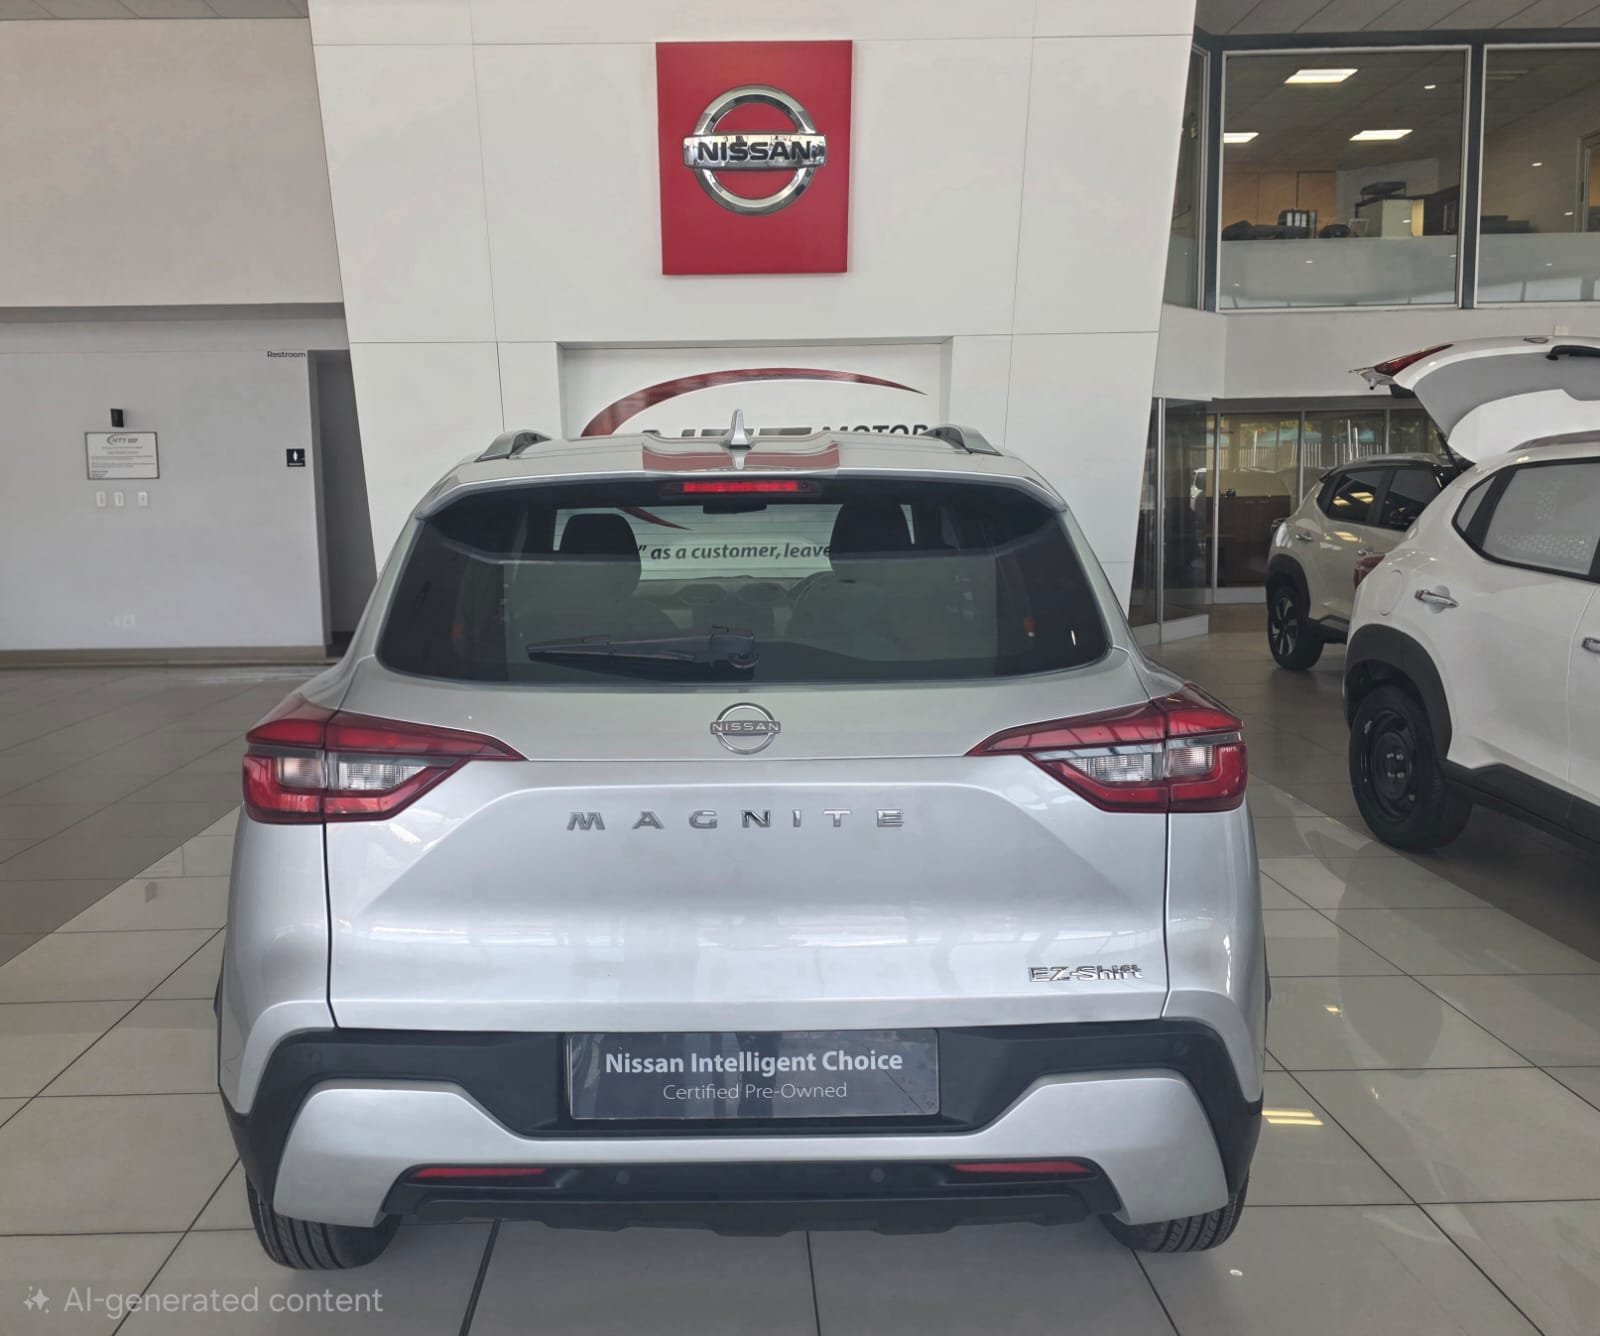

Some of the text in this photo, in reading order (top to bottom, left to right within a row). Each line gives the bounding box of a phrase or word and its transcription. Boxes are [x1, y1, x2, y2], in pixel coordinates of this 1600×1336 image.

[697, 141, 811, 161] NISSAN
[650, 547, 671, 560] as
[675, 549, 687, 559] a
[691, 544, 781, 560] customer,
[712, 722, 779, 731] NISSAN
[566, 808, 905, 831] MAGNITE
[1028, 964, 1143, 983] EZ-Shift
[605, 1050, 904, 1076] Nissan Intelligent Choice
[663, 1081, 848, 1100] Certified Pre-Owned
